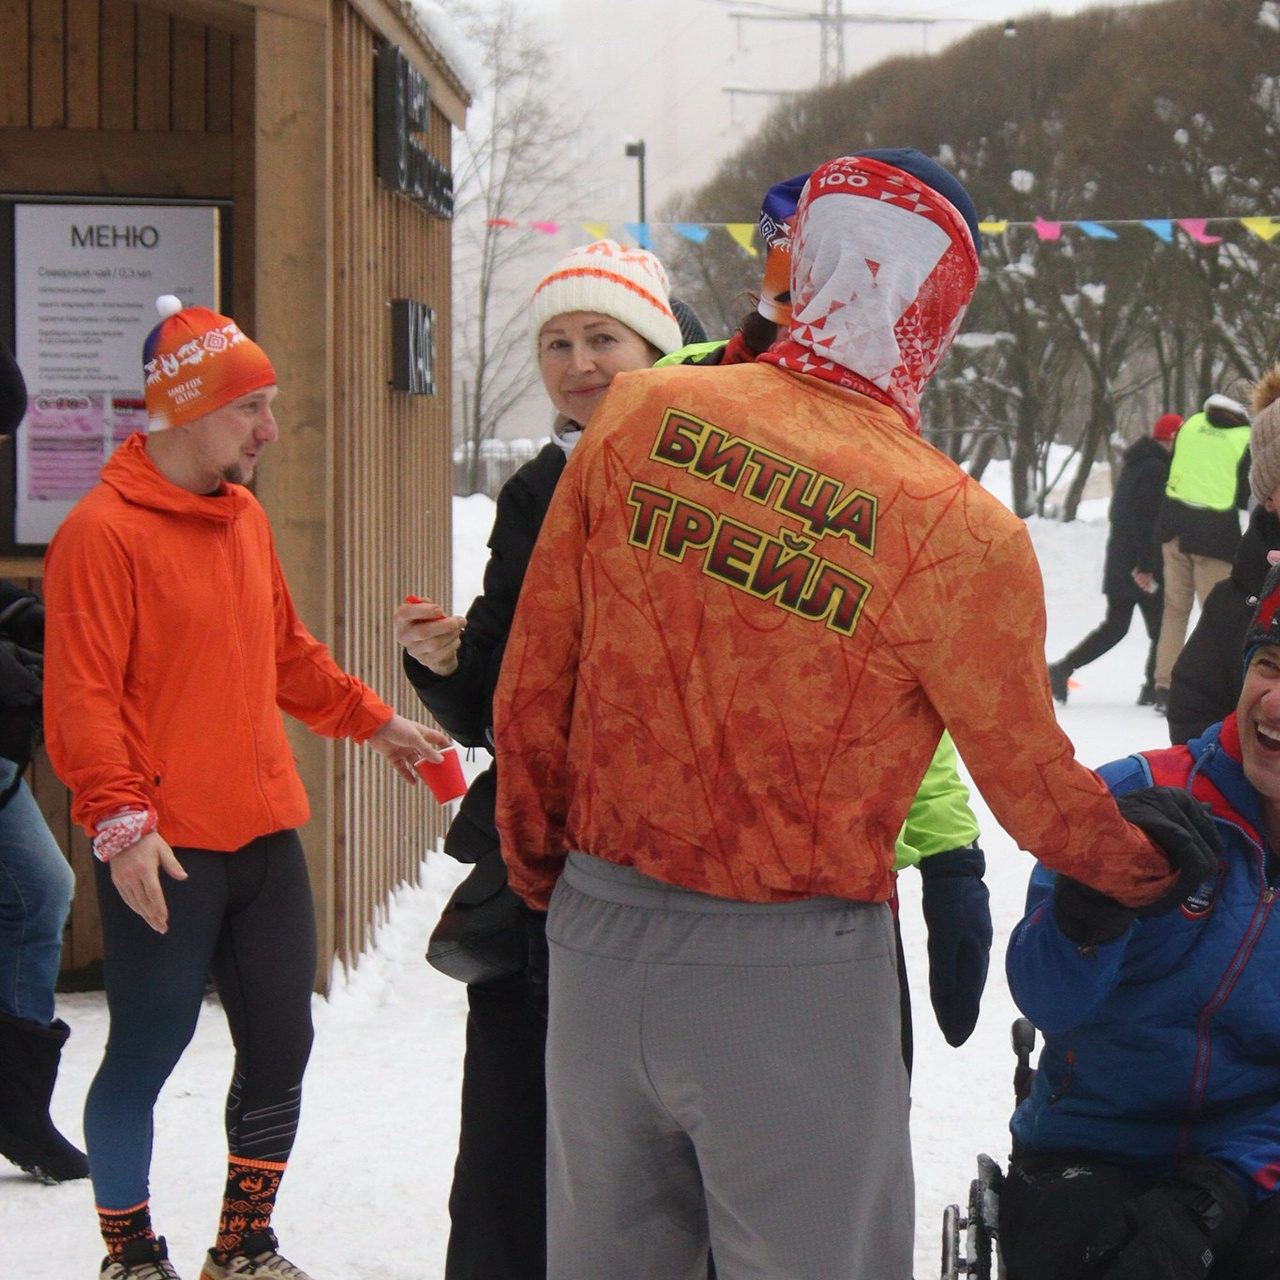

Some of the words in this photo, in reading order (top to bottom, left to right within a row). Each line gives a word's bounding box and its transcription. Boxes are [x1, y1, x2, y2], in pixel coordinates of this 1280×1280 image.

[819, 172, 869, 189] 100
[70, 224, 160, 249] МЕНЮ
[648, 406, 878, 558] БИТЦА
[626, 480, 874, 638] ТРЕЙЛ
